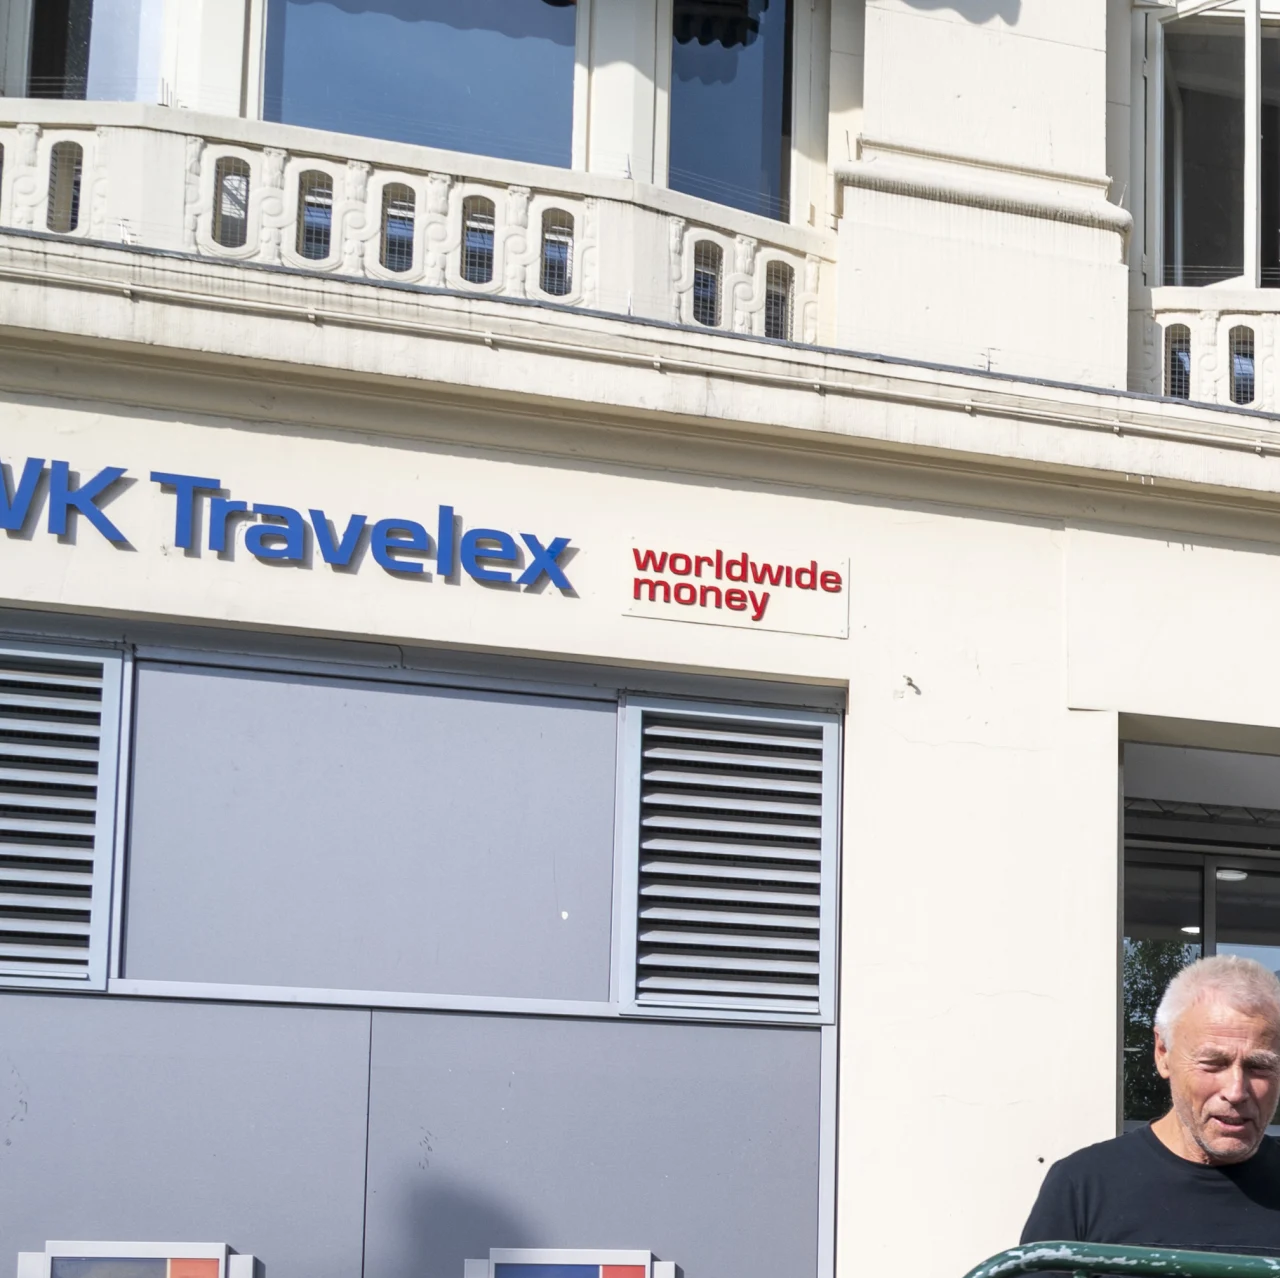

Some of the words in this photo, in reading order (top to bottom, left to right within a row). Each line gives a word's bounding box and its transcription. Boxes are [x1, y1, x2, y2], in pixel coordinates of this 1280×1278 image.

[149, 471, 572, 590] Travelex
[632, 548, 843, 593] worldwide
[633, 577, 771, 621] money
